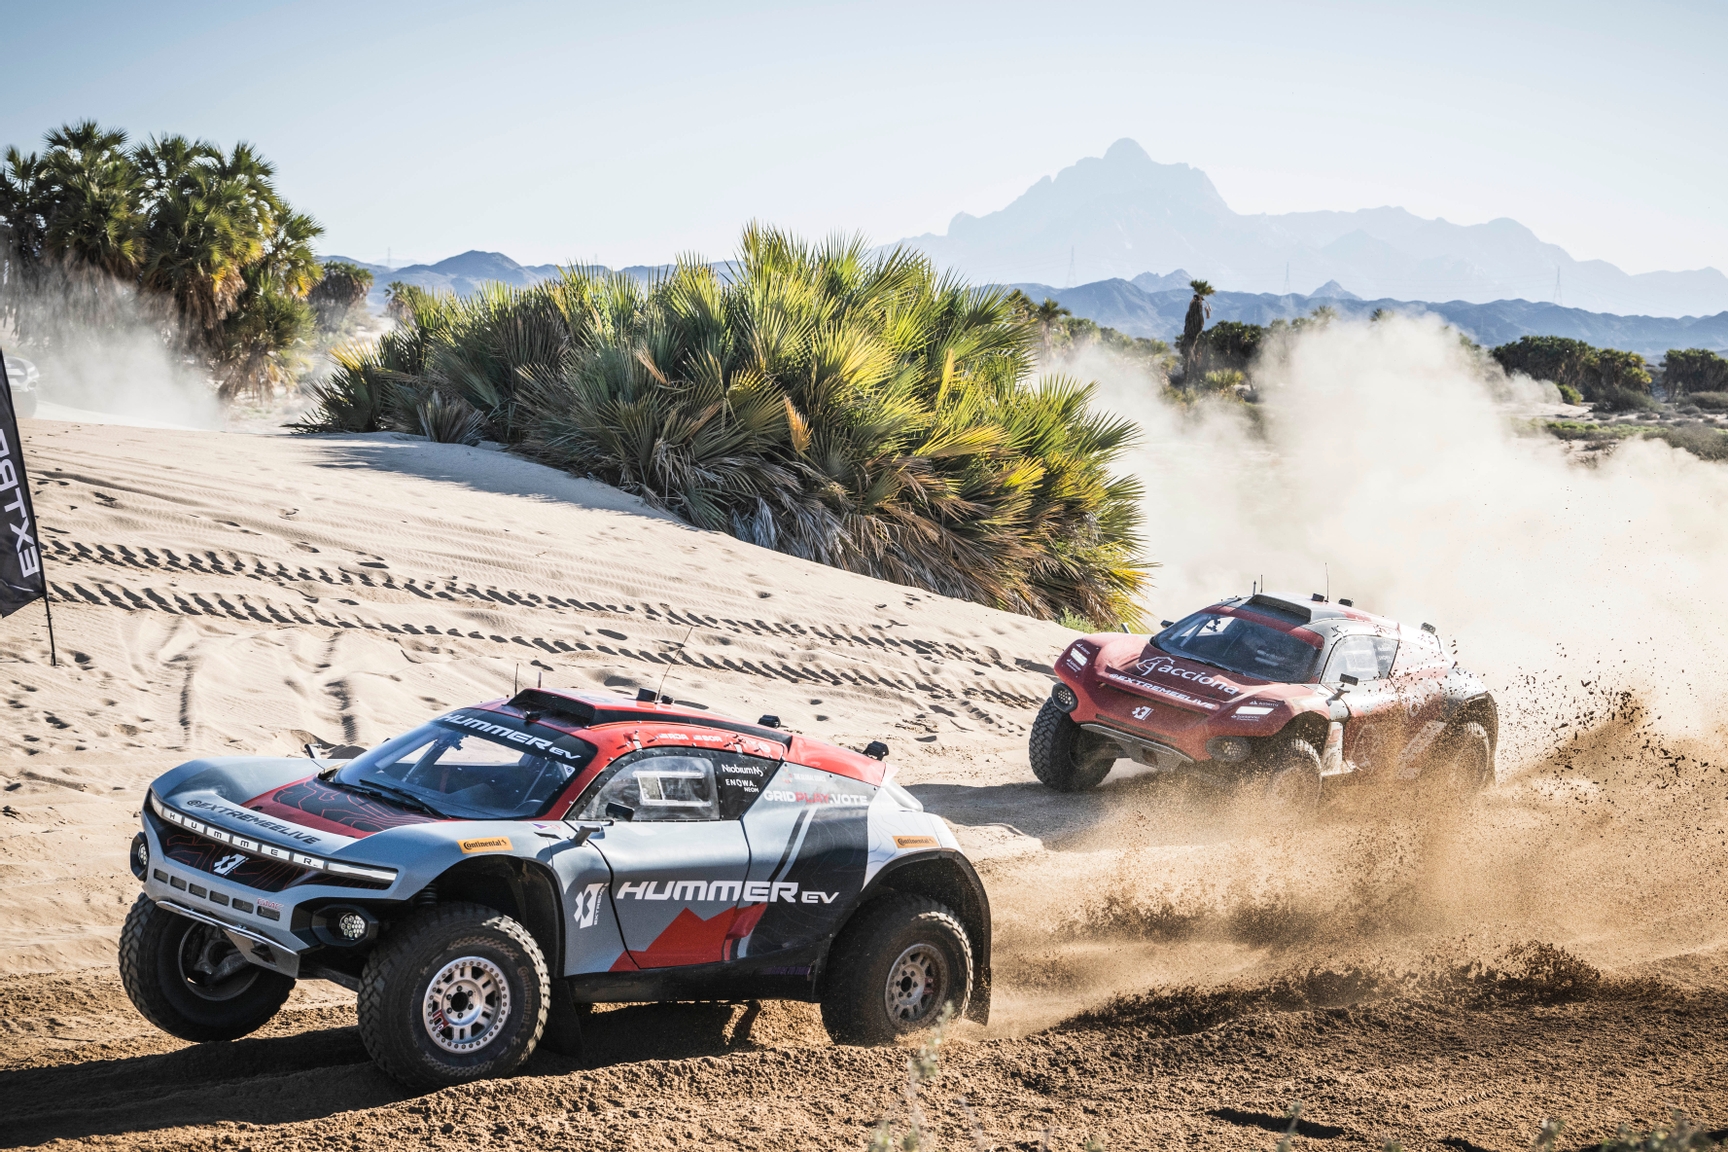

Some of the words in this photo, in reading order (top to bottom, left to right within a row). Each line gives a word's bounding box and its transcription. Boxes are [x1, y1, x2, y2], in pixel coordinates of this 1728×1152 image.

[1109, 673, 1216, 710] @EXTREMEELIVE
[1158, 664, 1240, 695] acciona
[438, 713, 553, 750] HUMMER
[549, 746, 581, 759] EV
[764, 790, 869, 806] GRIDPLAY.VOTE
[170, 812, 312, 865] HUMMER
[187, 799, 321, 845] @EXTREMEELIVE
[463, 839, 502, 850] Continental
[616, 880, 799, 903] HUMMER
[801, 891, 840, 904] EV
